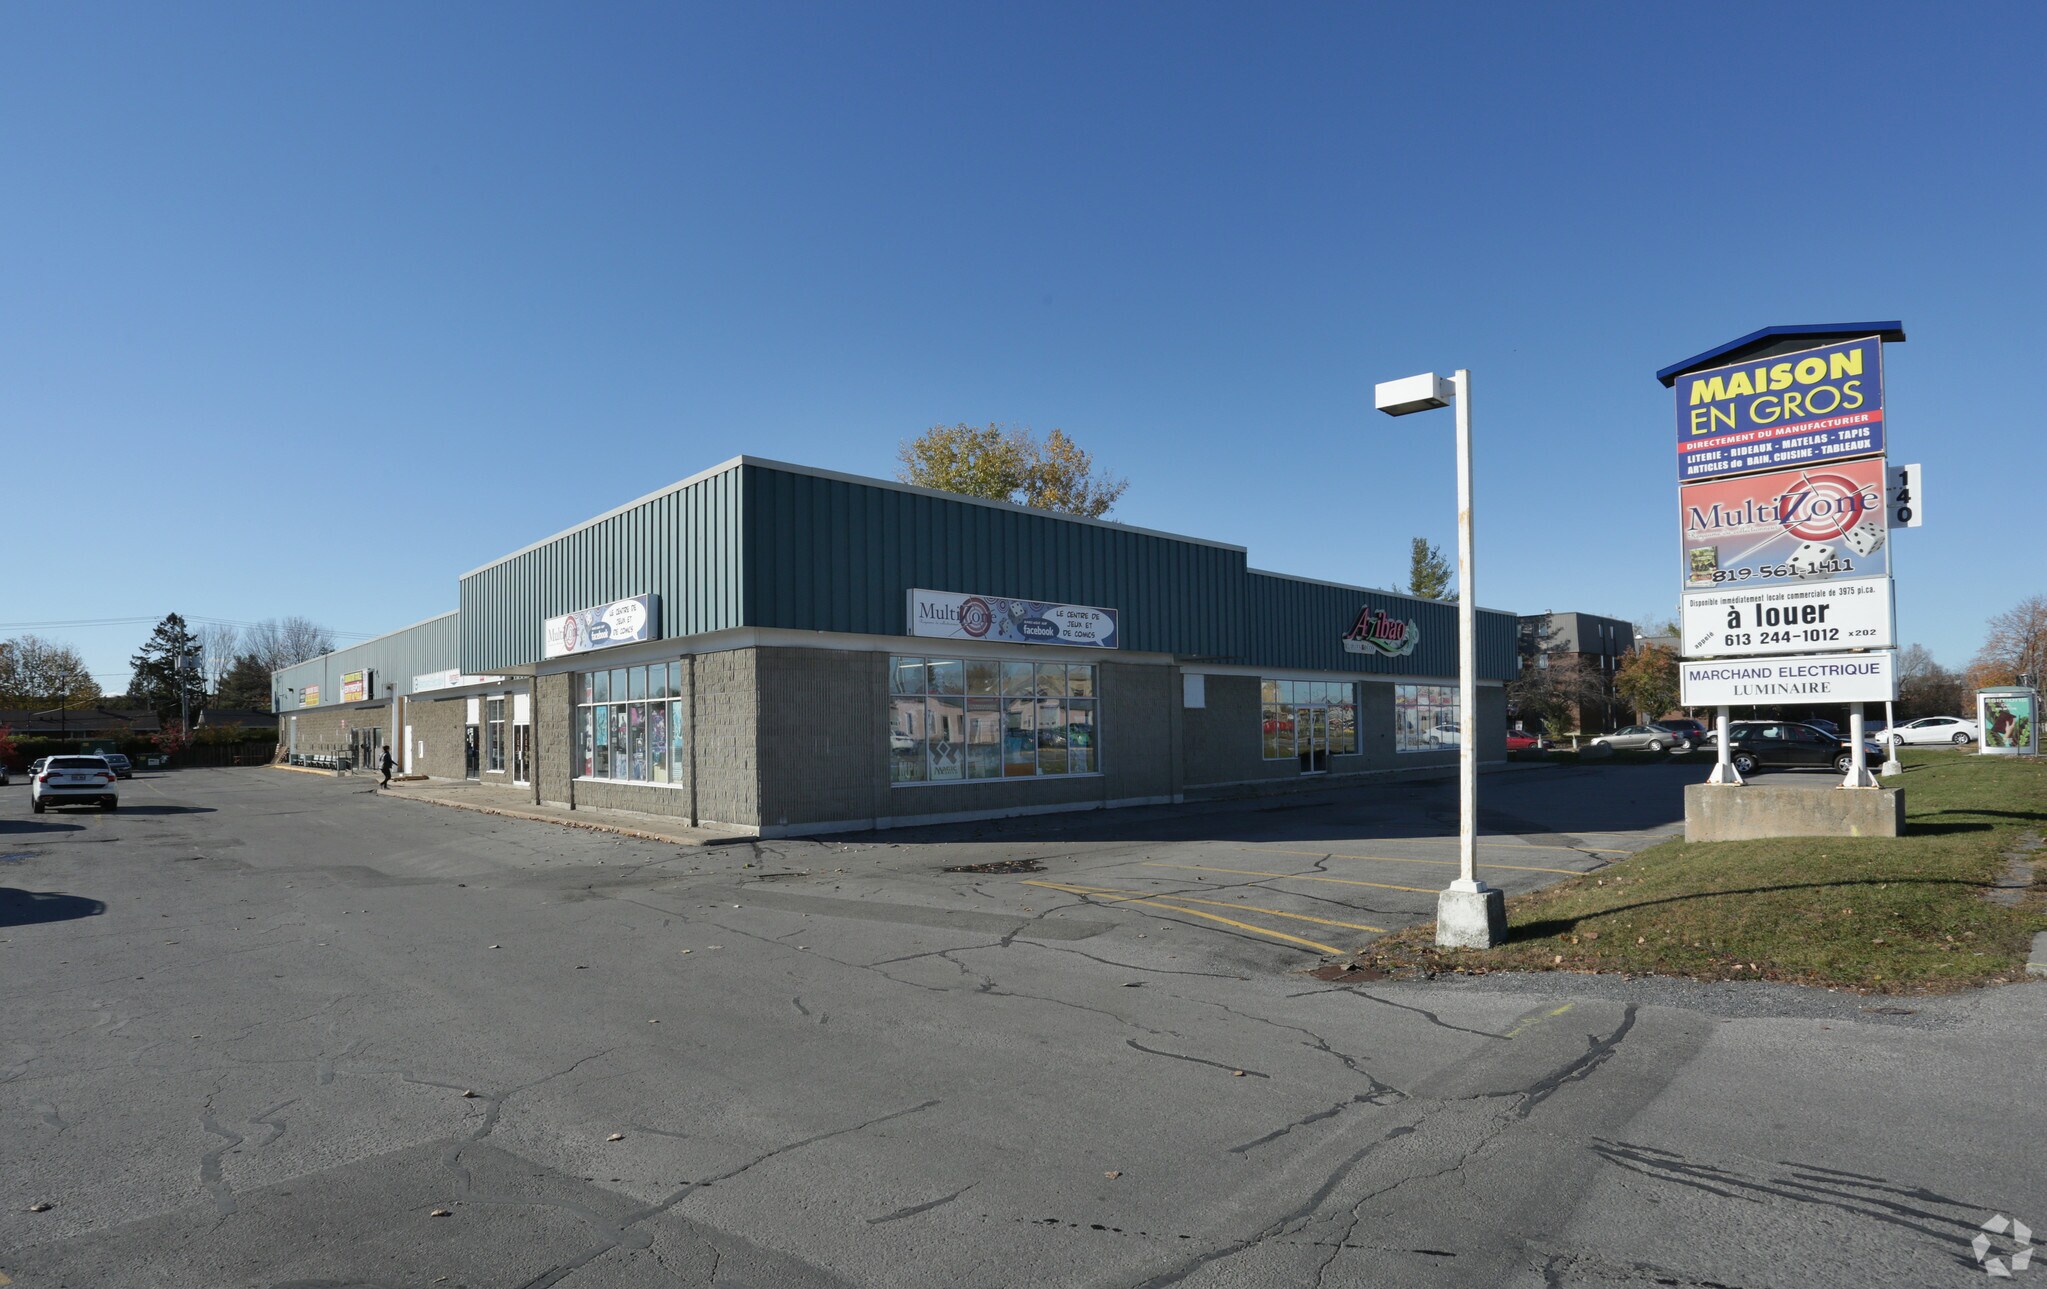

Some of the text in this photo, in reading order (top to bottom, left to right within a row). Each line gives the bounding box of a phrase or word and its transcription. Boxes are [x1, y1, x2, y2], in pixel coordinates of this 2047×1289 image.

[1689, 348, 1863, 406] MAISON
[1691, 380, 1863, 435] EN GROS
[1687, 414, 1869, 450] DIRECTEMENT DU MANUFACTURIER
[1687, 451, 1722, 464] LITERIE
[1731, 443, 1773, 457] RIDEAUX
[1782, 434, 1828, 449] MATELAS
[1838, 427, 1870, 440] TAPIS
[1687, 461, 1729, 475] ARTICLES
[1730, 460, 1743, 468] de
[1747, 454, 1772, 466] BAIN,
[1774, 448, 1813, 461] CUISINE
[1821, 439, 1871, 455] TABLEAUX
[1712, 558, 1854, 583] 819-561-1411
[1689, 598, 1718, 607] Disponible
[1720, 594, 1764, 604] immédiatement
[1766, 593, 1785, 601] locale
[1787, 590, 1826, 600] commerciale
[1839, 586, 1855, 595] 3975
[1067, 611, 1088, 620] CENTRE
[1727, 603, 1829, 629] à louer
[1023, 624, 1054, 636] facebook
[1062, 629, 1095, 639] DE COMICS
[1725, 628, 1876, 646] 613 244-1012 x202
[1689, 662, 1880, 681] MARCHAND ELECTRIQUE
[1734, 681, 1831, 696] LUMINAIRE
